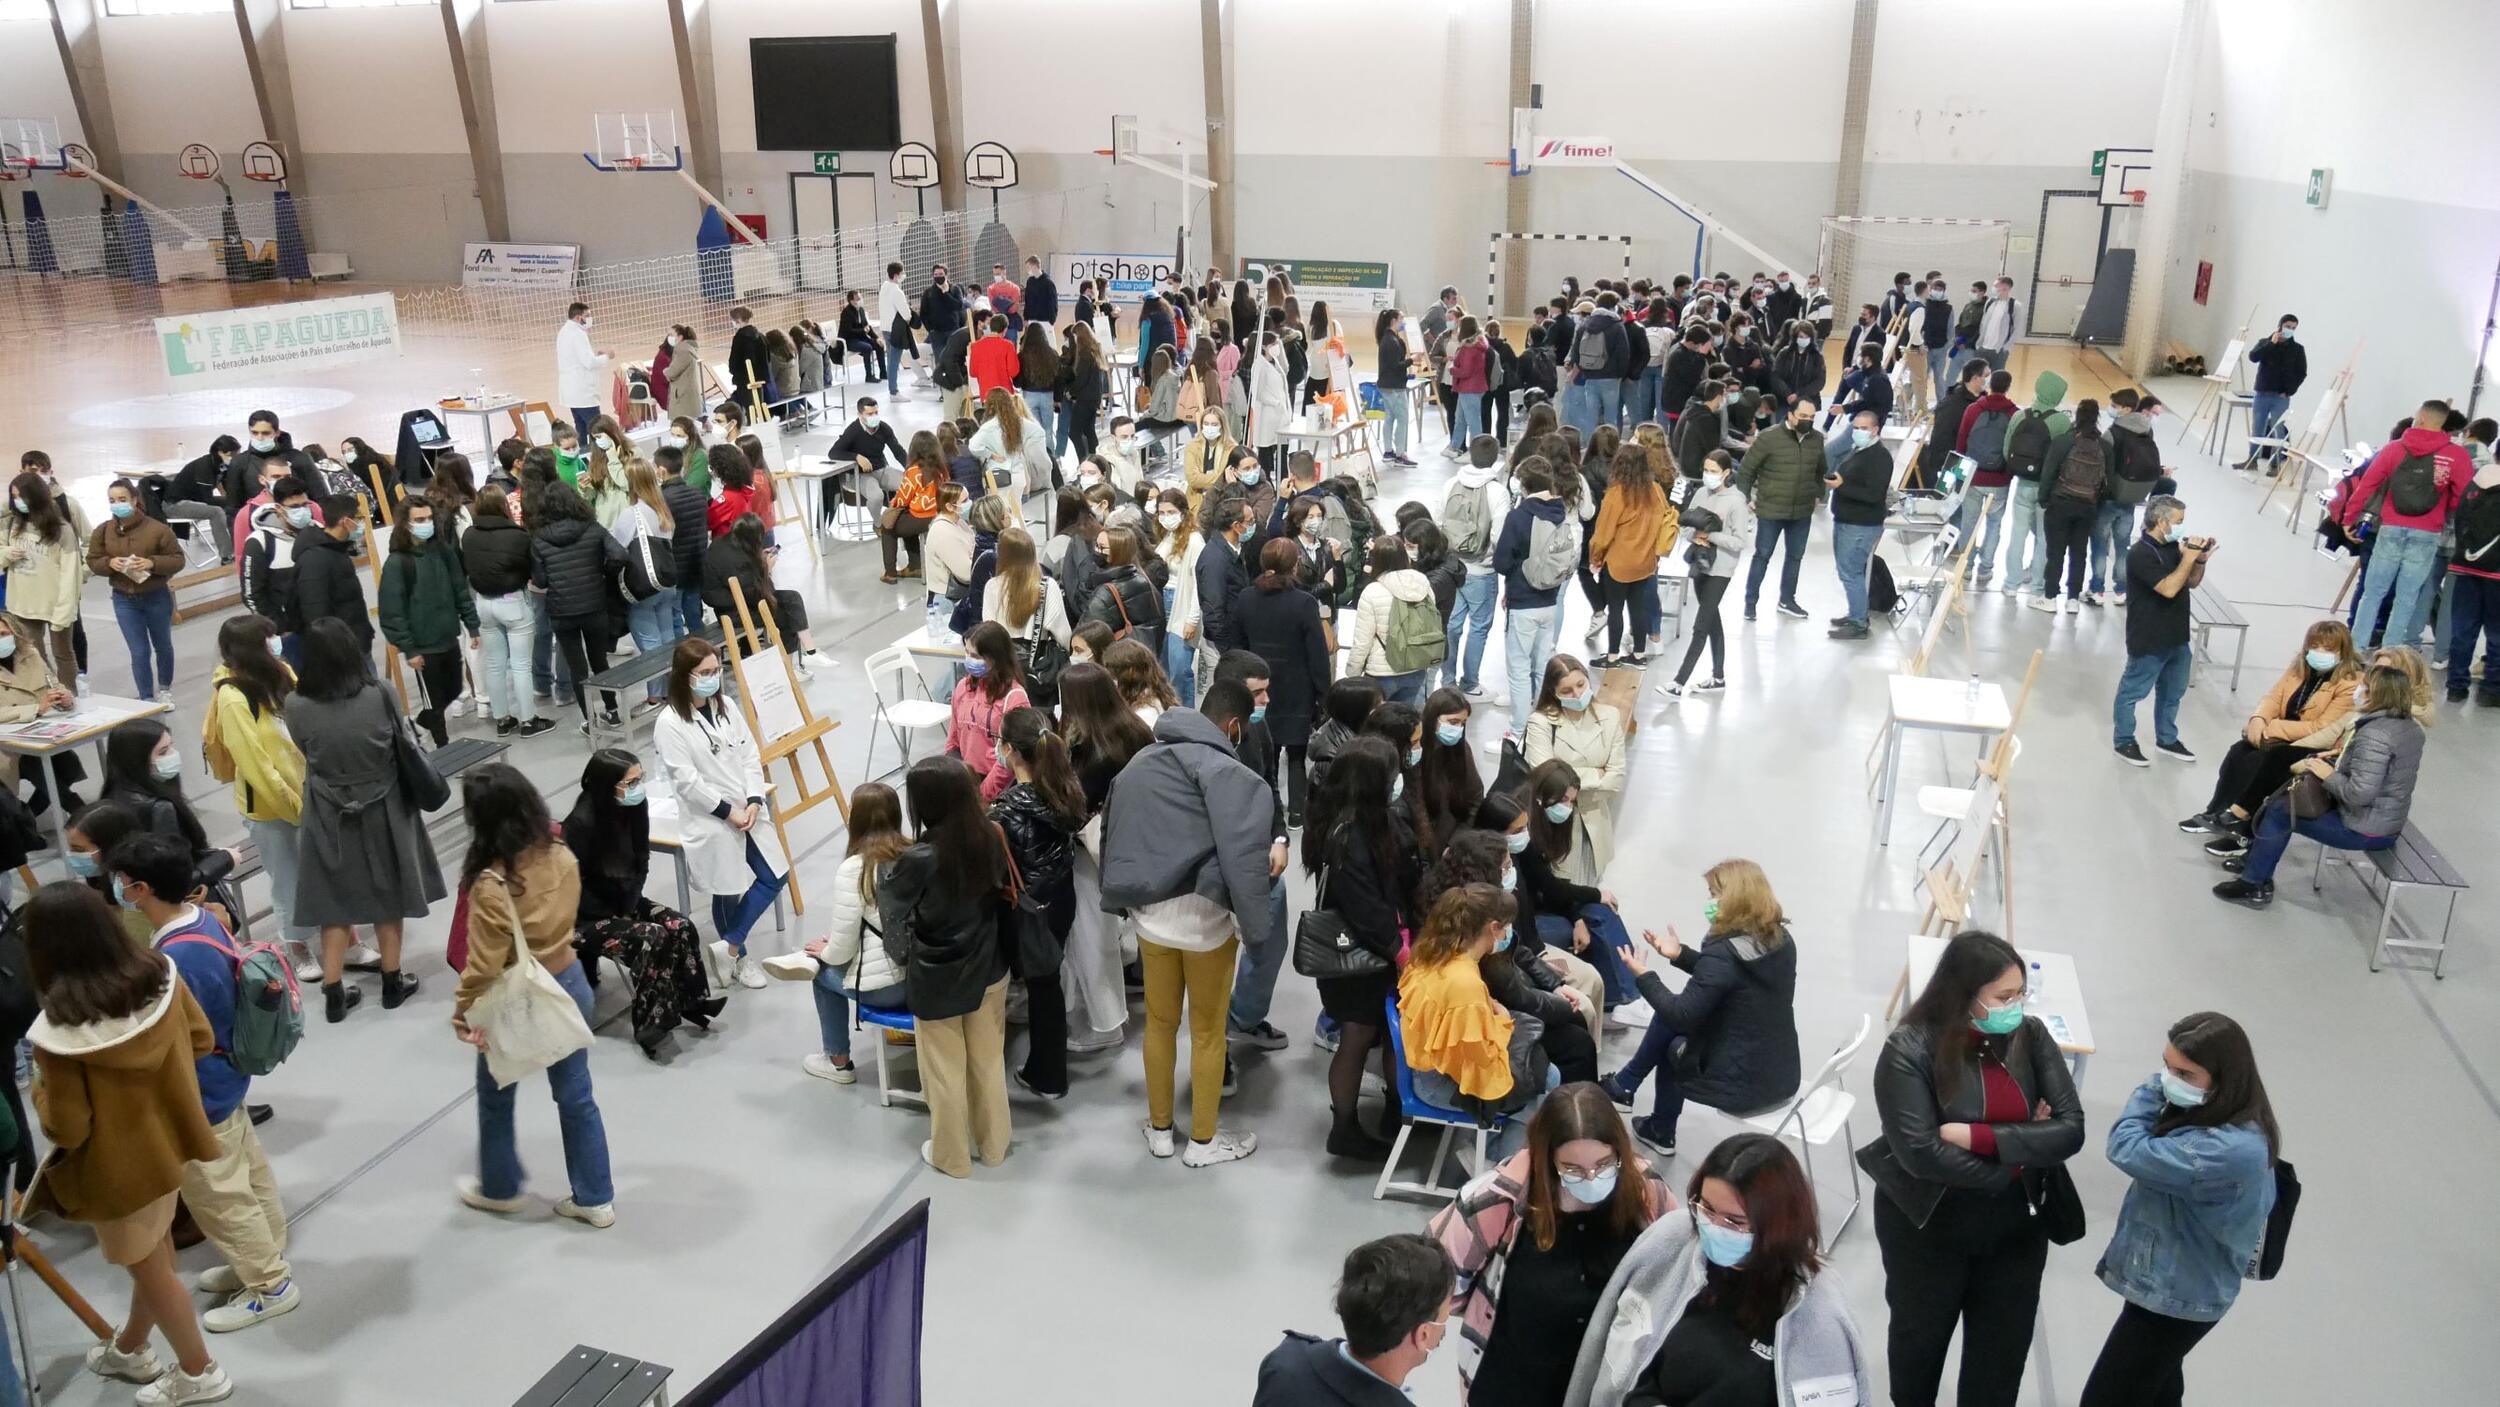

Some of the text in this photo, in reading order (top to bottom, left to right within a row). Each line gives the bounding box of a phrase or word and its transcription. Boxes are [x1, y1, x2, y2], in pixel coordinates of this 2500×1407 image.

[464, 264, 480, 272] Ford
[1116, 280, 1132, 289] bike
[207, 306, 390, 358] FAPAGUEDA
[212, 351, 250, 371] Federação
[250, 356, 260, 365] de
[260, 351, 300, 363] Associações
[300, 348, 309, 358] de
[332, 340, 361, 353] Concelho
